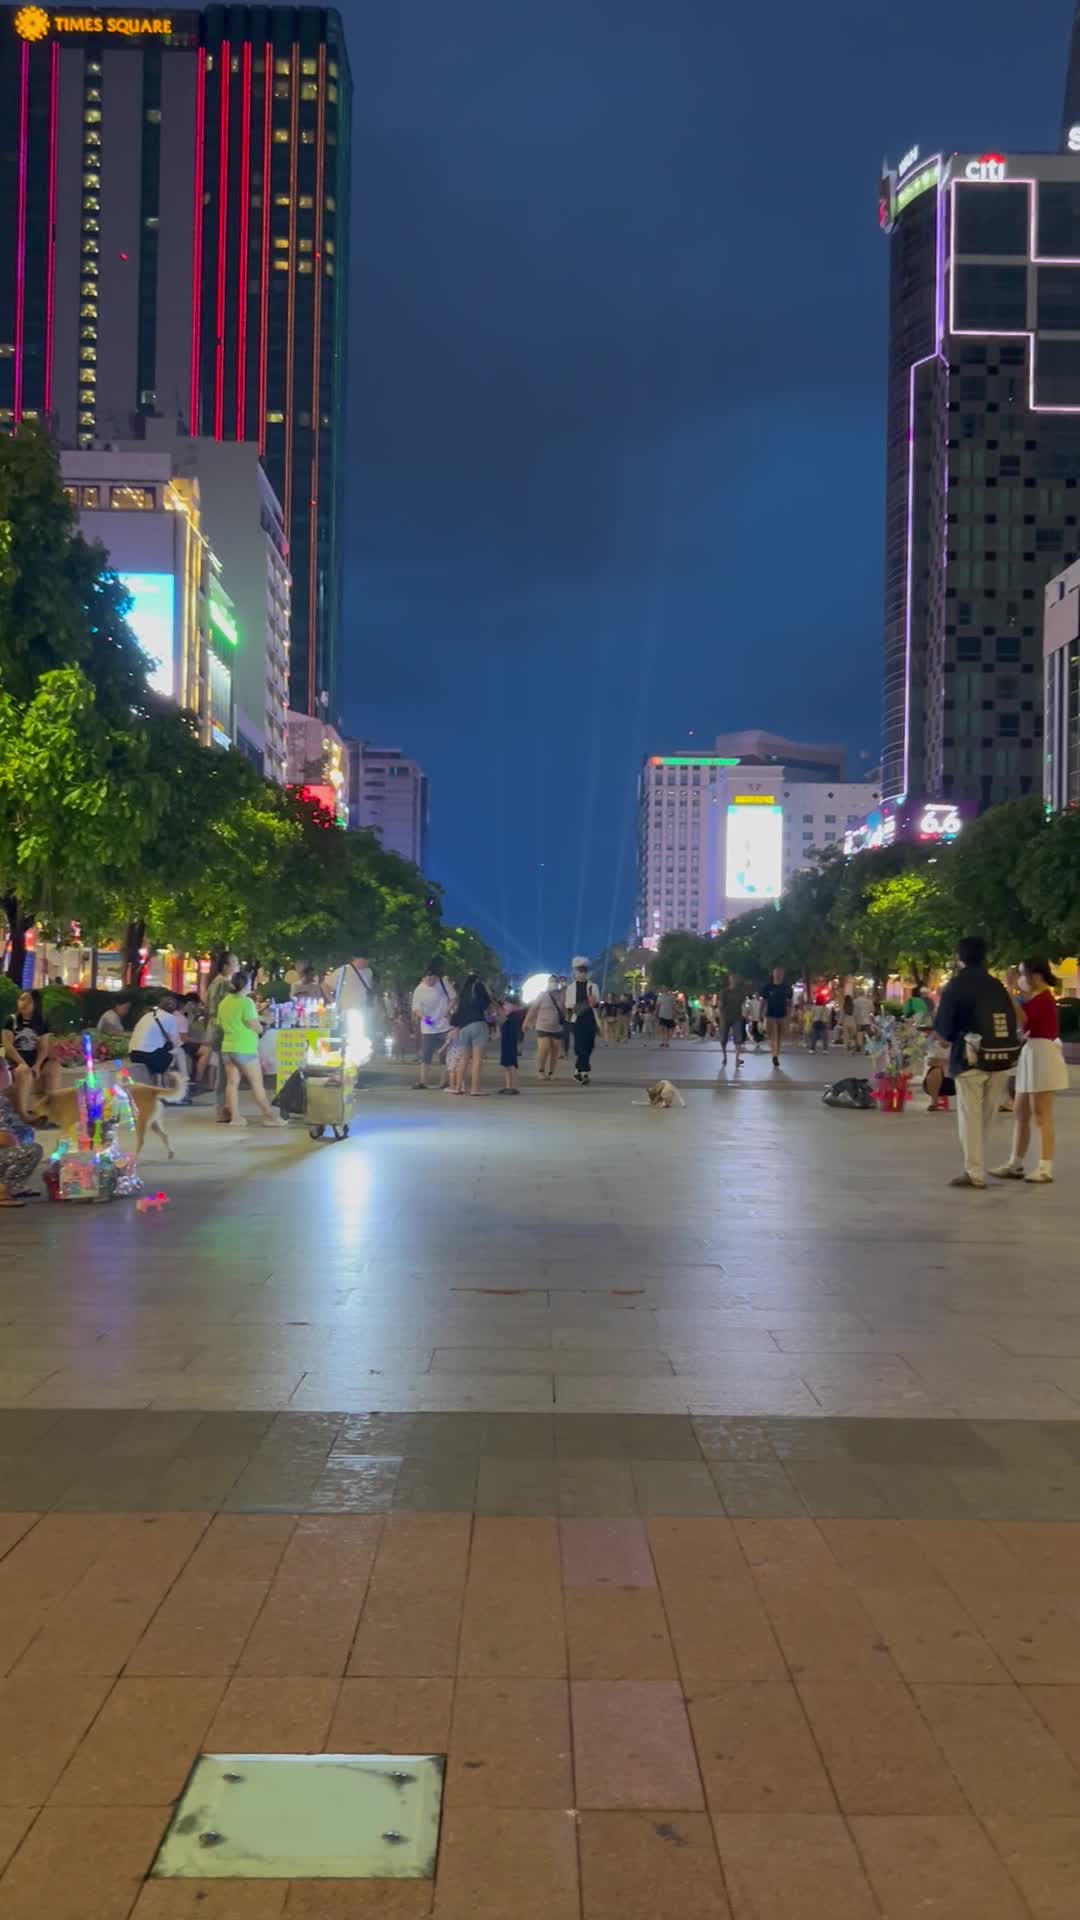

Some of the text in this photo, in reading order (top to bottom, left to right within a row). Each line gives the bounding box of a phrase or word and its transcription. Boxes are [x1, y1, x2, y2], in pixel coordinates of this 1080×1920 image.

[54, 17, 172, 36] TIMES SQUARE
[965, 158, 1006, 180] citi
